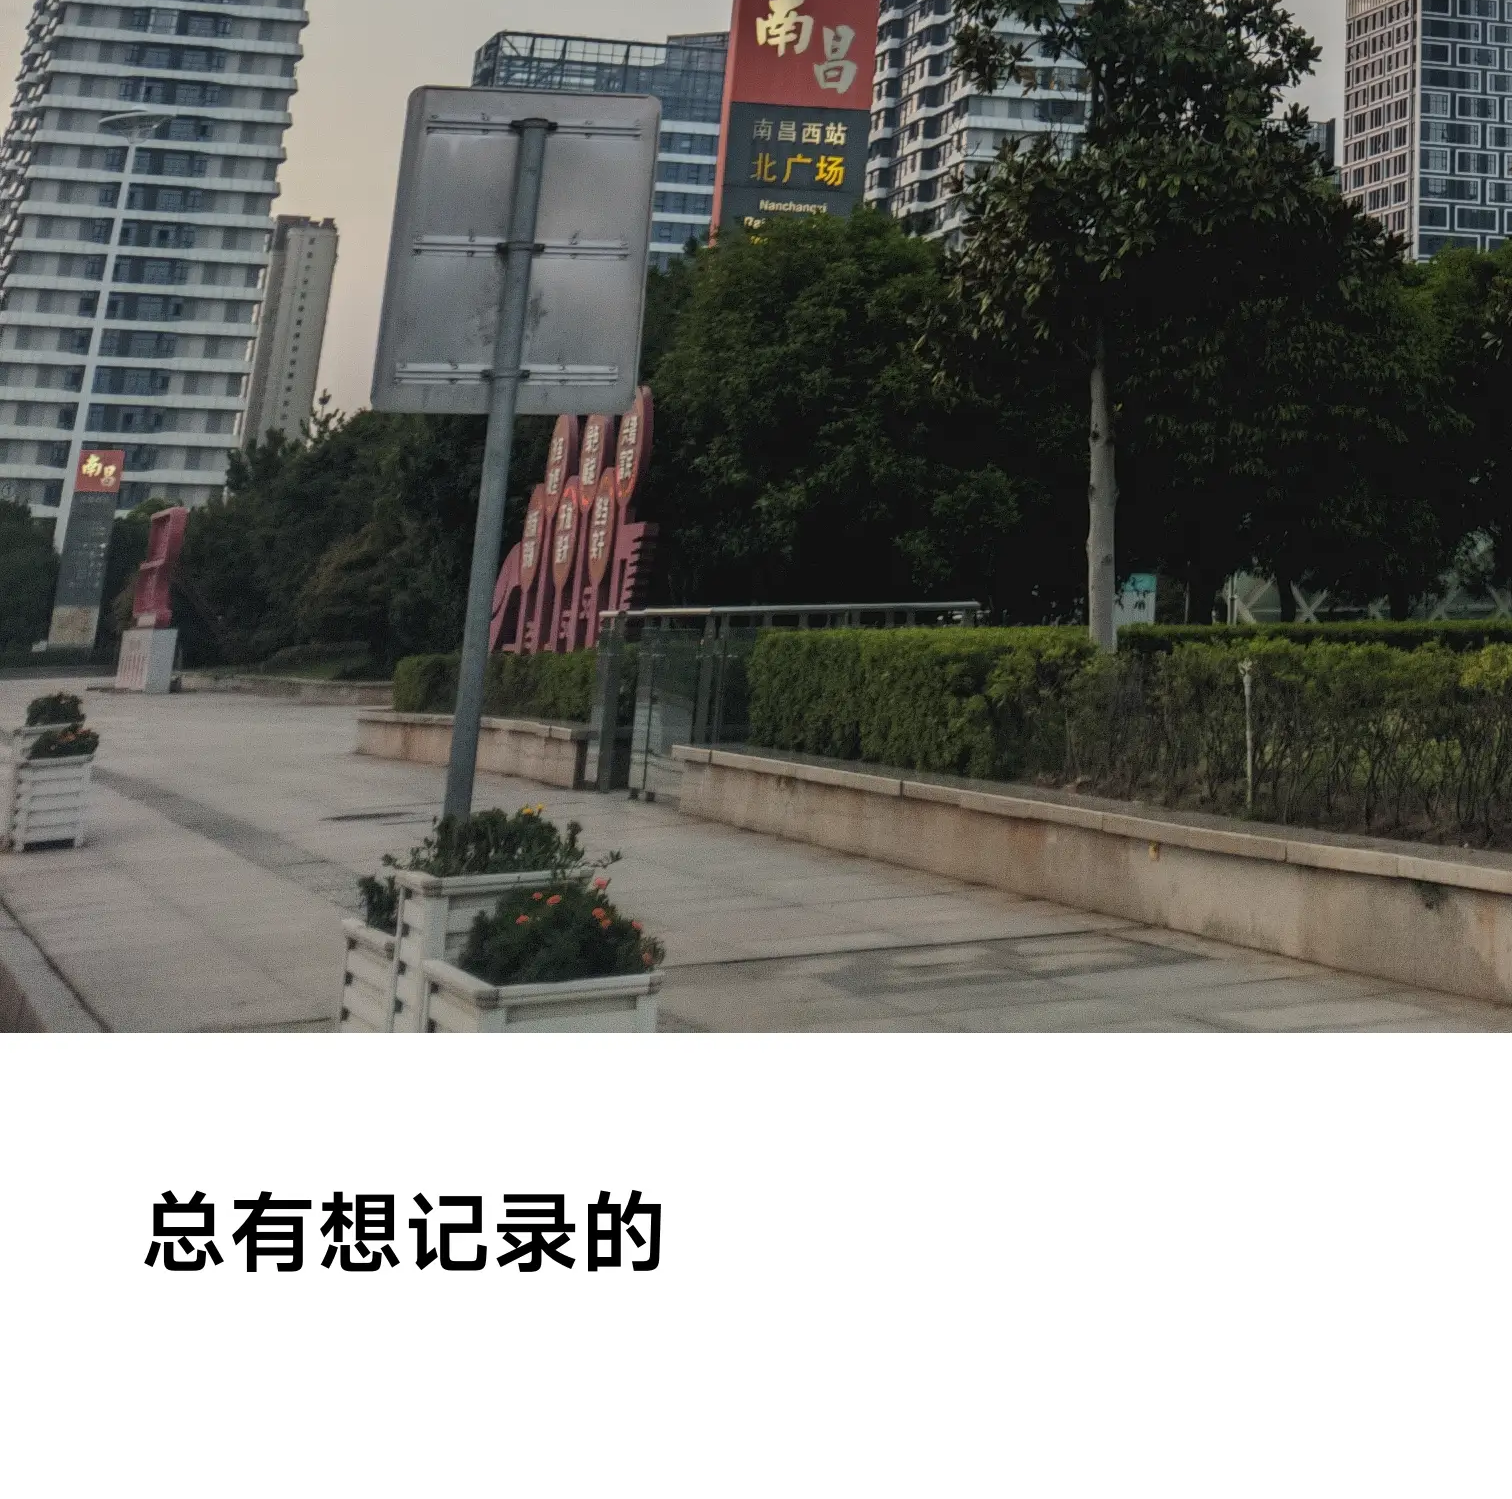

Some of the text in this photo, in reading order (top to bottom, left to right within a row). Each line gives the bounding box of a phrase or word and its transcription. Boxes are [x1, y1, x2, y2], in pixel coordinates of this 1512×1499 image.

[752, 118, 848, 146] 南昌西站
[750, 153, 846, 187] 北广场
[82, 454, 117, 487] 南昌
